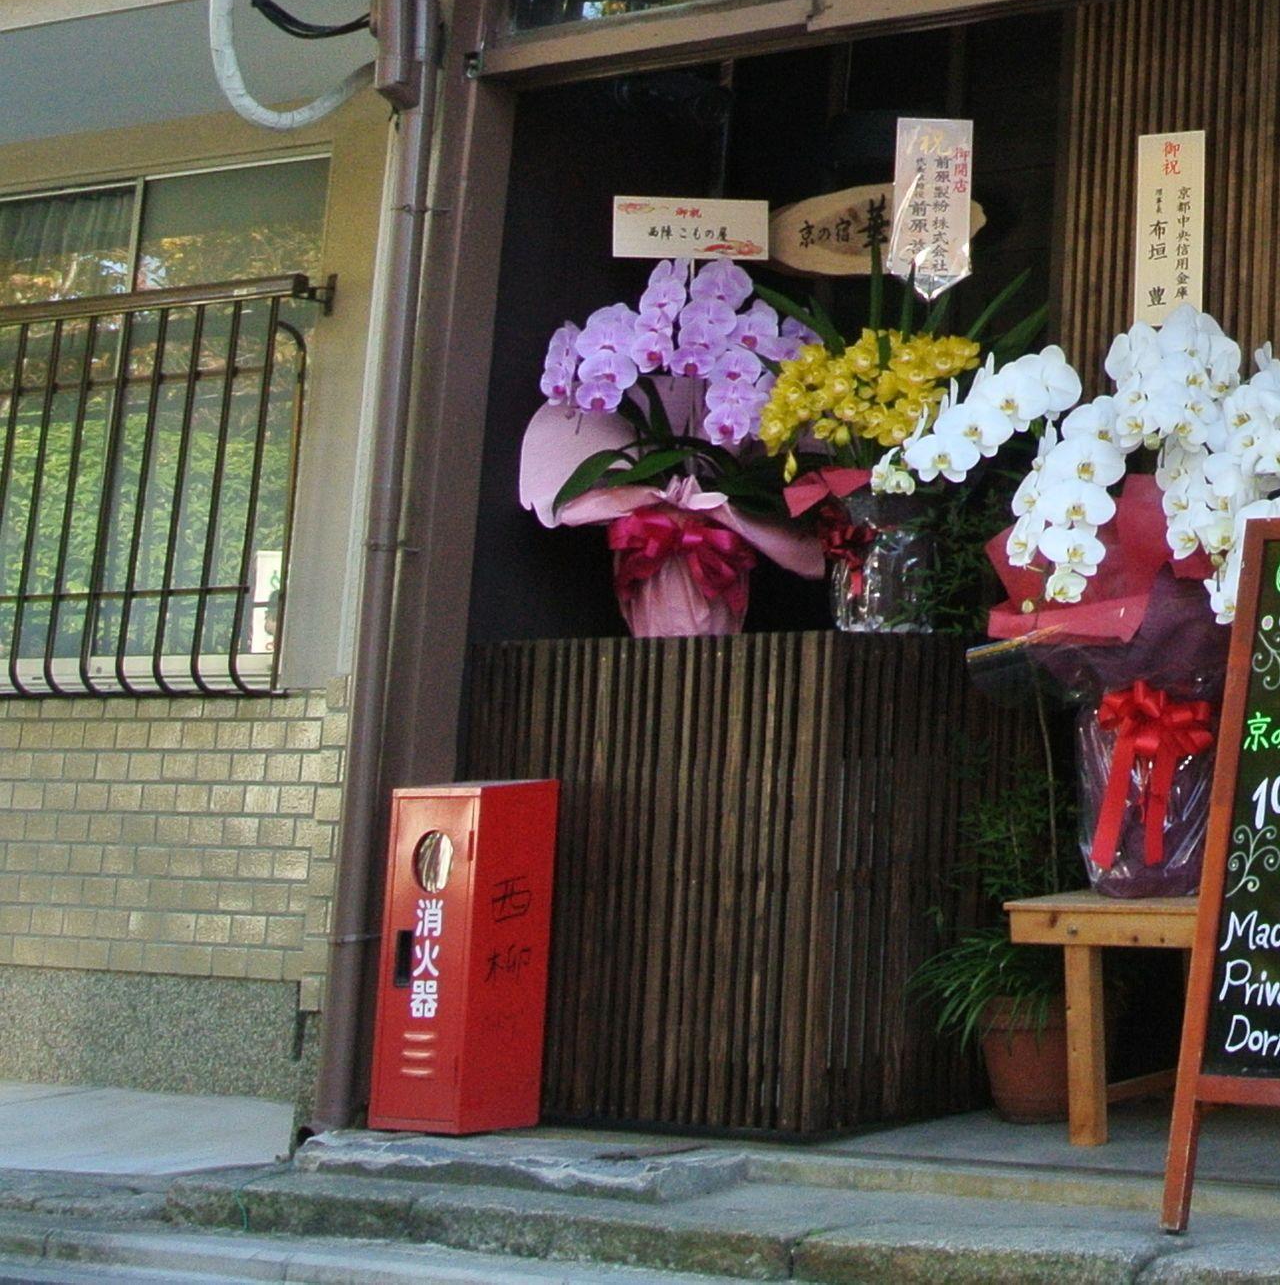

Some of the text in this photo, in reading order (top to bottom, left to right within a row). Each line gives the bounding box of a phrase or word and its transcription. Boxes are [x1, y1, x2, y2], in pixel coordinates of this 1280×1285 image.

[1162, 141, 1182, 176] 御祝
[799, 219, 852, 248] 京の宿
[1148, 220, 1169, 260] 布垣
[1174, 186, 1192, 300] 京都中央信用金庫
[410, 898, 444, 1019] 消火器
